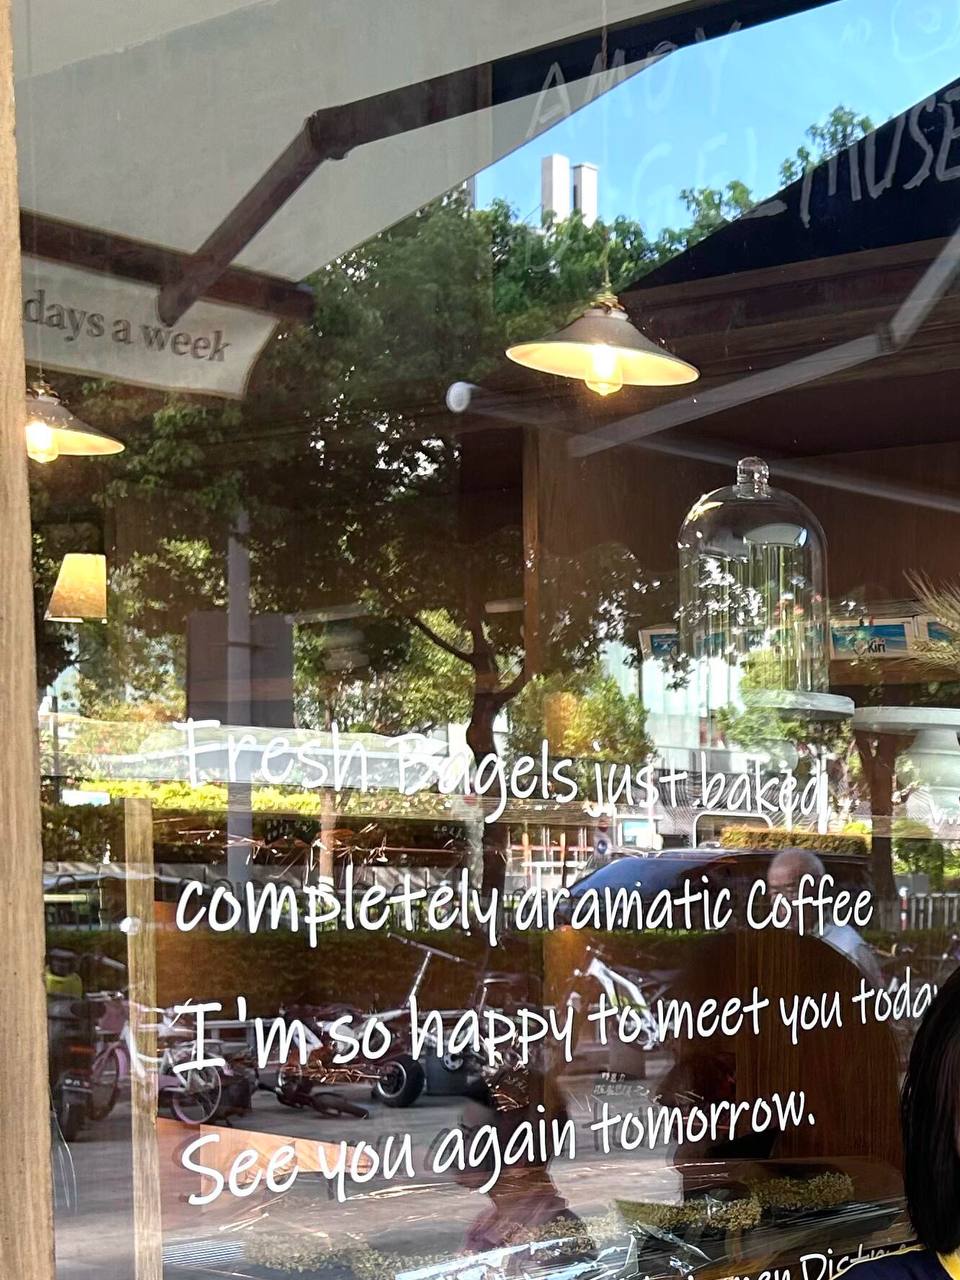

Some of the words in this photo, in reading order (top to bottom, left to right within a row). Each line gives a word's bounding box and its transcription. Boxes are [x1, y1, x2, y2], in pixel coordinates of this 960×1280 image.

[24, 289, 105, 342] days
[112, 318, 132, 345] a
[139, 323, 231, 361] week
[172, 717, 369, 791] Fresh
[386, 736, 578, 823] Bagels
[584, 741, 687, 817] just
[175, 865, 499, 948] completely
[515, 862, 732, 930] dramatic
[747, 873, 874, 937] Coffee
[172, 996, 307, 1073] I'm
[332, 1014, 392, 1064] so
[408, 995, 574, 1066] happy
[588, 993, 641, 1044] to
[657, 986, 770, 1039] meet
[780, 992, 842, 1044] you
[851, 966, 938, 1025] toda
[181, 1133, 299, 1206] See
[318, 1128, 415, 1201] you
[432, 1105, 576, 1193] again
[590, 1090, 815, 1154] tomorrow.
